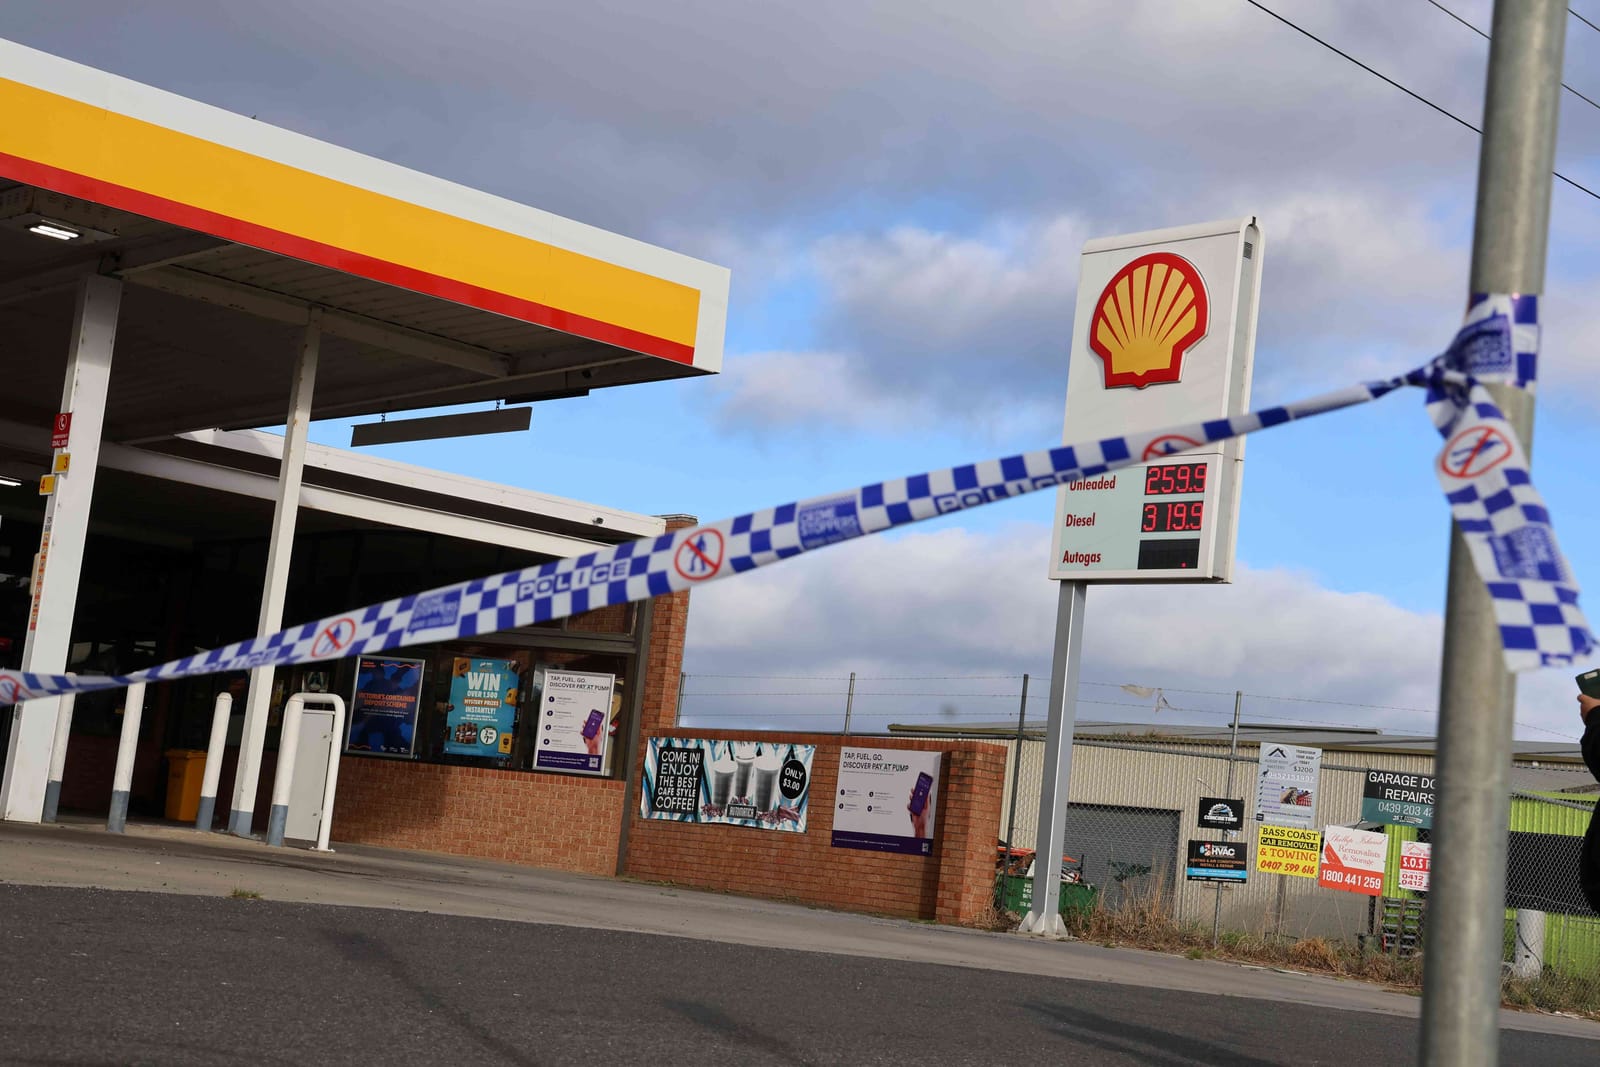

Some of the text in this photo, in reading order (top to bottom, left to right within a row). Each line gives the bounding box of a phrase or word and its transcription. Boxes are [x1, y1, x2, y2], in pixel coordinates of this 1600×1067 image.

[1069, 465, 1207, 494] Unleaded 259.9
[1065, 503, 1204, 532] Diesel 319.9
[1062, 550, 1102, 567] Autogas
[518, 559, 631, 601] POLICE
[467, 672, 501, 691] WIN
[386, 694, 416, 703] CONTAINER
[467, 690, 482, 698] OVER
[465, 706, 496, 715] INSTANTLY!
[661, 751, 701, 764] COME IN!
[660, 763, 699, 776] ENJOY
[842, 761, 910, 772] DISCOVER PAY AT PUMP
[784, 767, 804, 780] ONLY
[1368, 771, 1418, 788] GARAGE
[659, 776, 698, 788] THE BEST
[782, 778, 800, 791] $3.00
[658, 787, 696, 798] CAFE STYLE
[1384, 788, 1436, 804] REPAIRS
[656, 796, 695, 812] COFFEE!
[1378, 801, 1400, 814] 0439
[1402, 804, 1420, 816] 203
[1262, 828, 1318, 841] BASS COAST
[1212, 846, 1236, 856] HVAC
[1261, 838, 1318, 851] CAR REMOVALS
[1338, 844, 1381, 858] Removalists
[1260, 848, 1317, 862] & TOWING
[1342, 853, 1375, 865] & Storage
[1260, 860, 1315, 875] 0407 599 616
[1402, 856, 1424, 869] S.O.S
[1322, 869, 1381, 890] 1800 441 259
[1402, 873, 1424, 881] 0412
